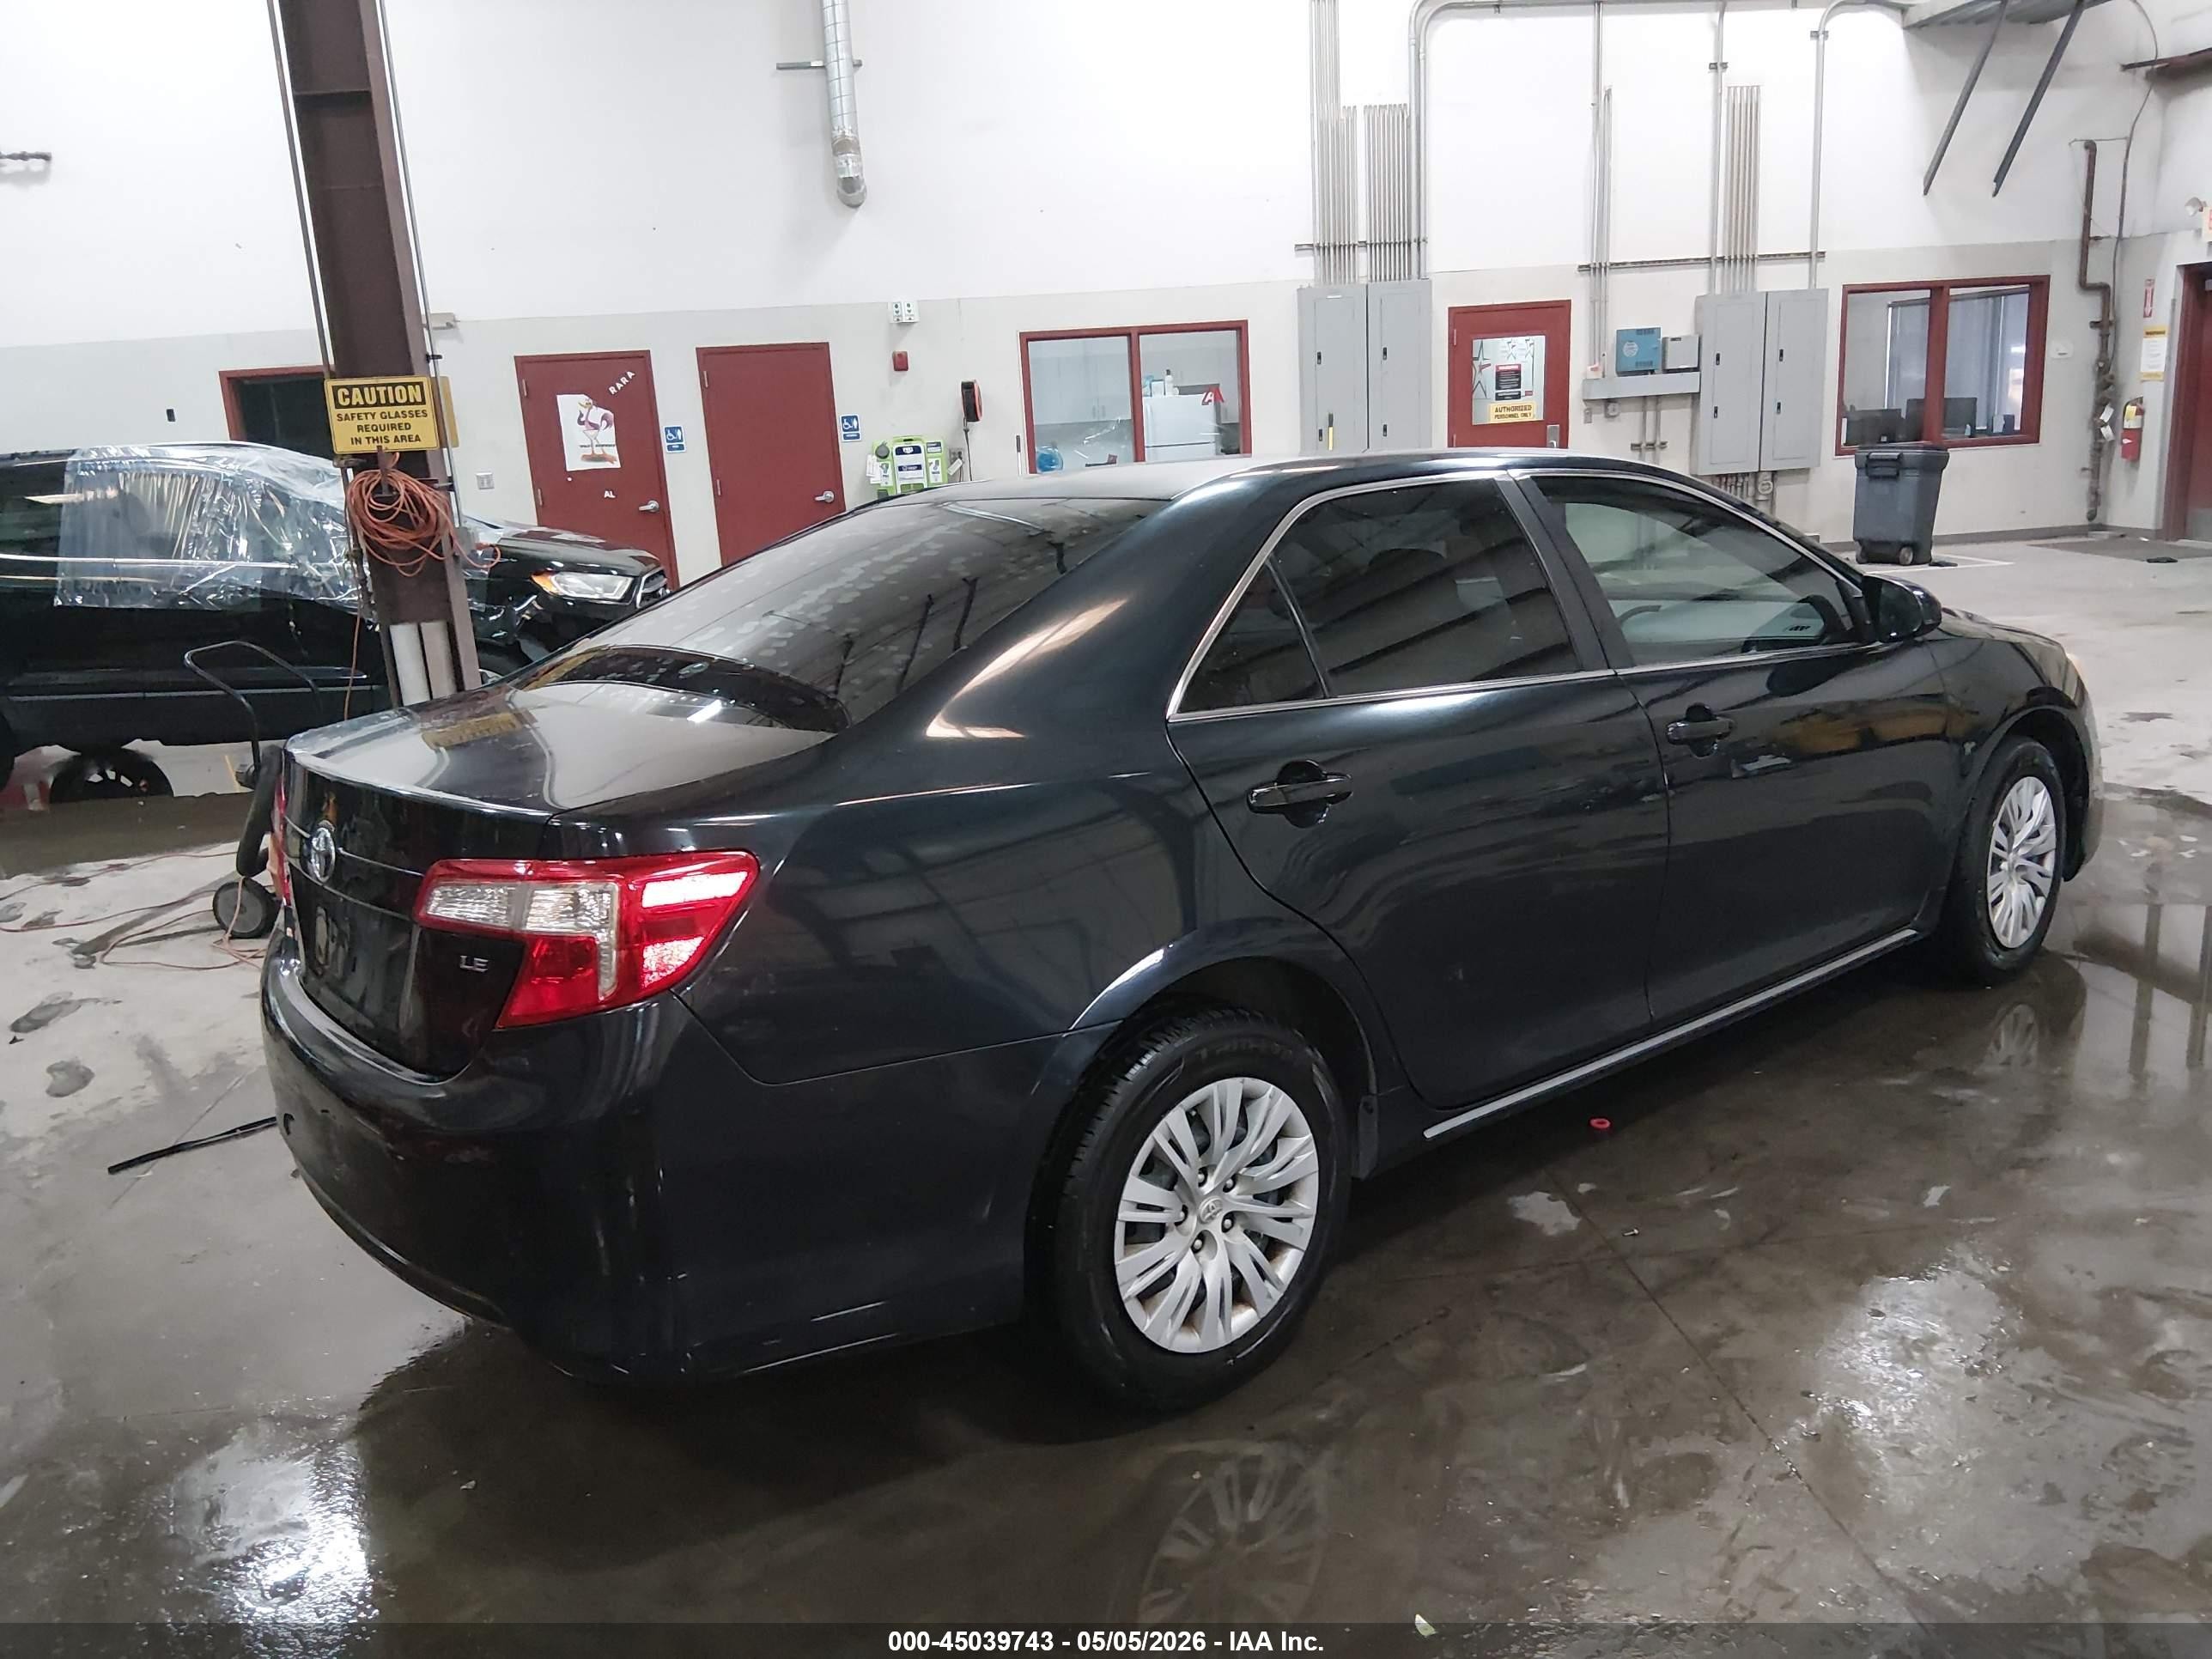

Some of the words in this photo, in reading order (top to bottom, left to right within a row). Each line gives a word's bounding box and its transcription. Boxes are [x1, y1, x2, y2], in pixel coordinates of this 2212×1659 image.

[608, 370, 636, 395] RARA
[337, 384, 422, 406] CAUTION
[1494, 404, 1532, 413] AUTHORIZED
[336, 412, 376, 422] SAFETY
[380, 410, 428, 420] GLASSES
[356, 422, 411, 433] REQUIRED
[350, 437, 362, 446] IN
[365, 436, 390, 445] THIS
[393, 434, 422, 443] AREA
[459, 955, 489, 973] LE
